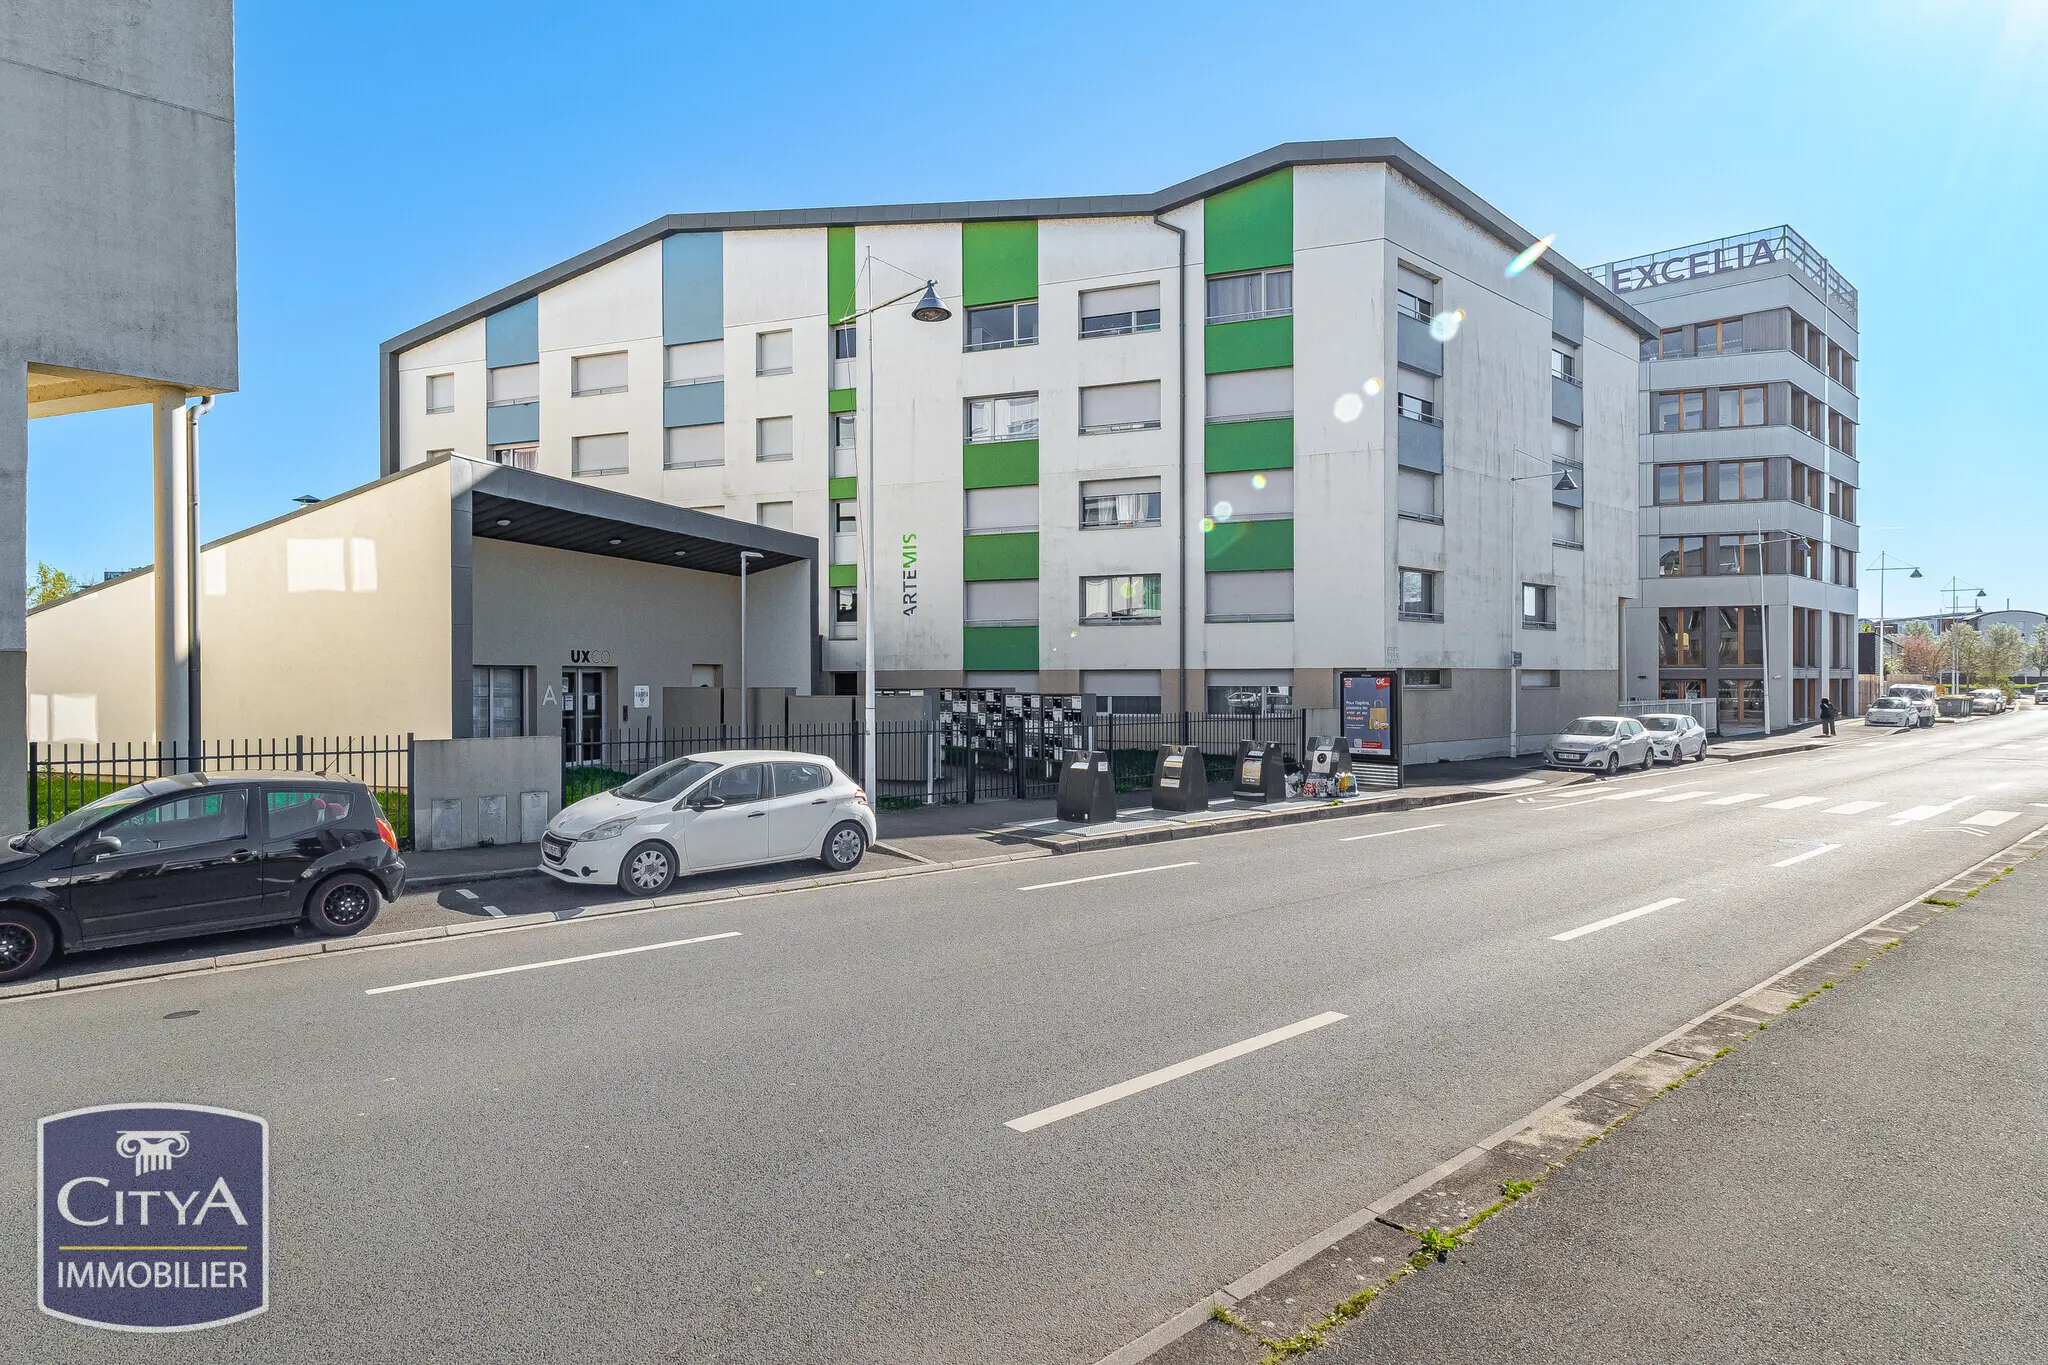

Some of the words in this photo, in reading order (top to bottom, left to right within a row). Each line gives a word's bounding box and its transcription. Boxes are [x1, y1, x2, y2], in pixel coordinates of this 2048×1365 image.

[1613, 238, 1777, 294] EXCELIA
[902, 533, 917, 616] ARTEMIS
[570, 649, 611, 664] UXCO
[542, 684, 558, 706] A
